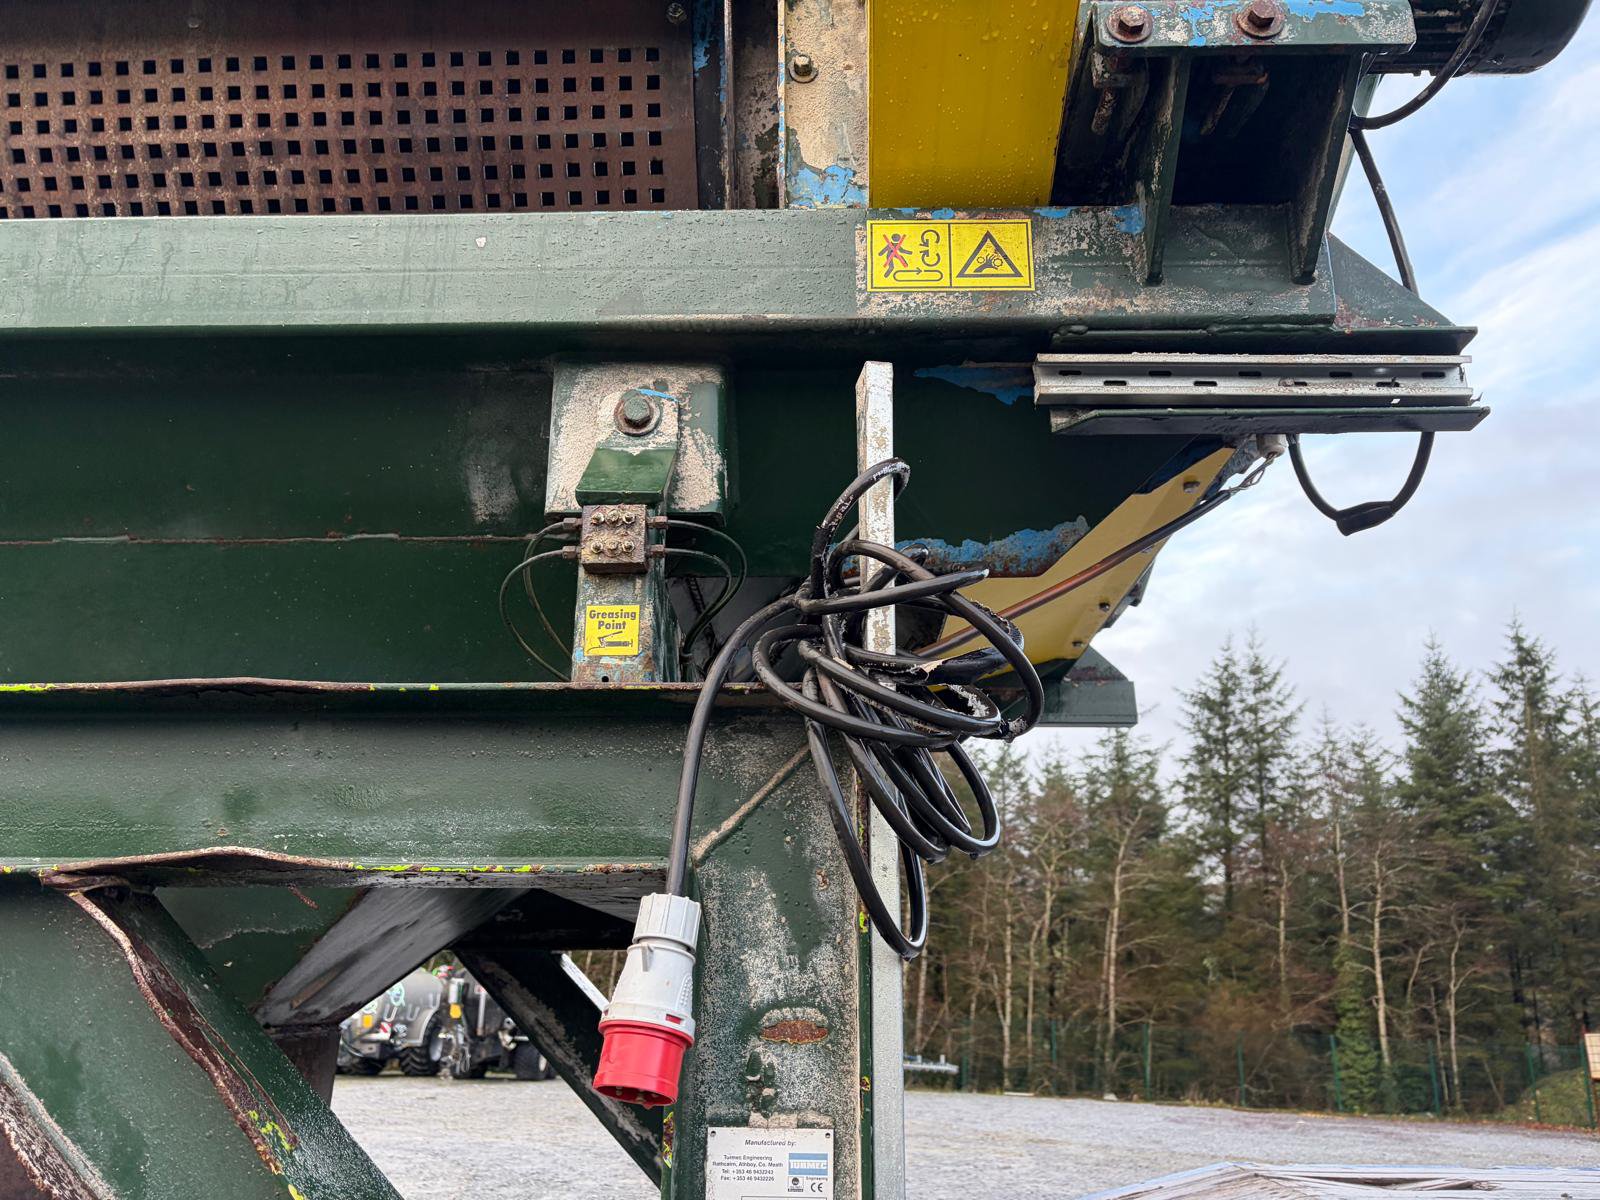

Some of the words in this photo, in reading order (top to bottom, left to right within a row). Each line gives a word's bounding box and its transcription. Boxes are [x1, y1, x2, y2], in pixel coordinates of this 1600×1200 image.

[589, 608, 636, 620] Greasing
[598, 620, 626, 630] Point
[810, 1182, 823, 1192] CE
